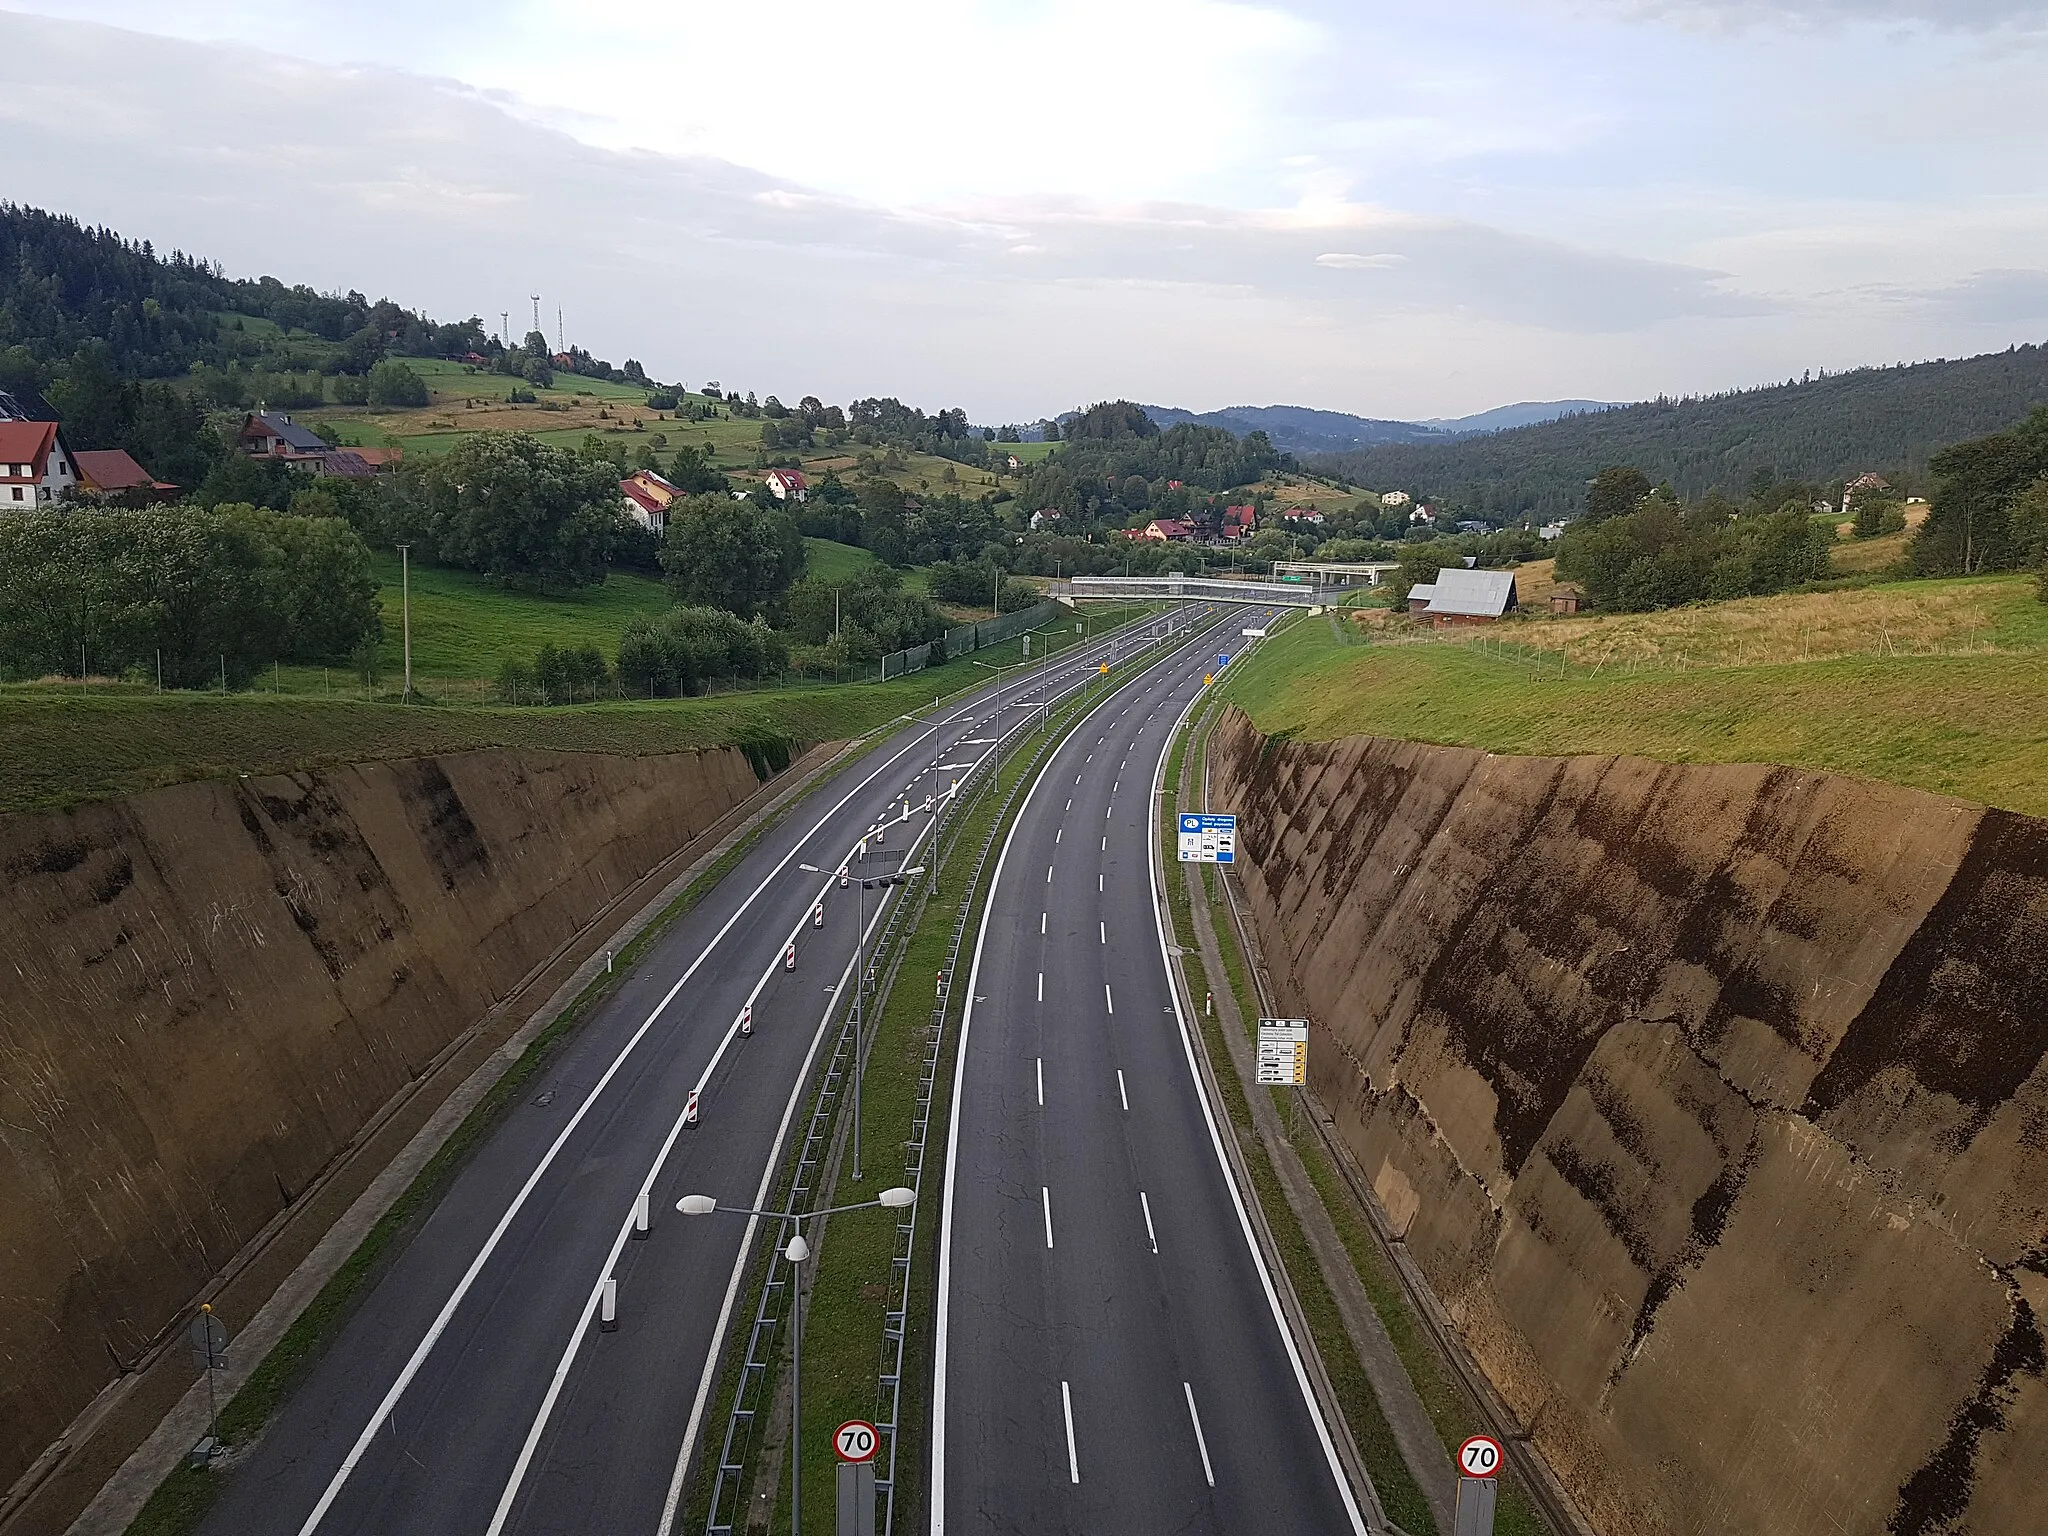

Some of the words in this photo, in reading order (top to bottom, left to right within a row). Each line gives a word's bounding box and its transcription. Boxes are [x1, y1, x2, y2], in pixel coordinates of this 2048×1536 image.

[1186, 819, 1196, 827] PL
[842, 1431, 872, 1452] 70
[1467, 1447, 1495, 1467] 70
